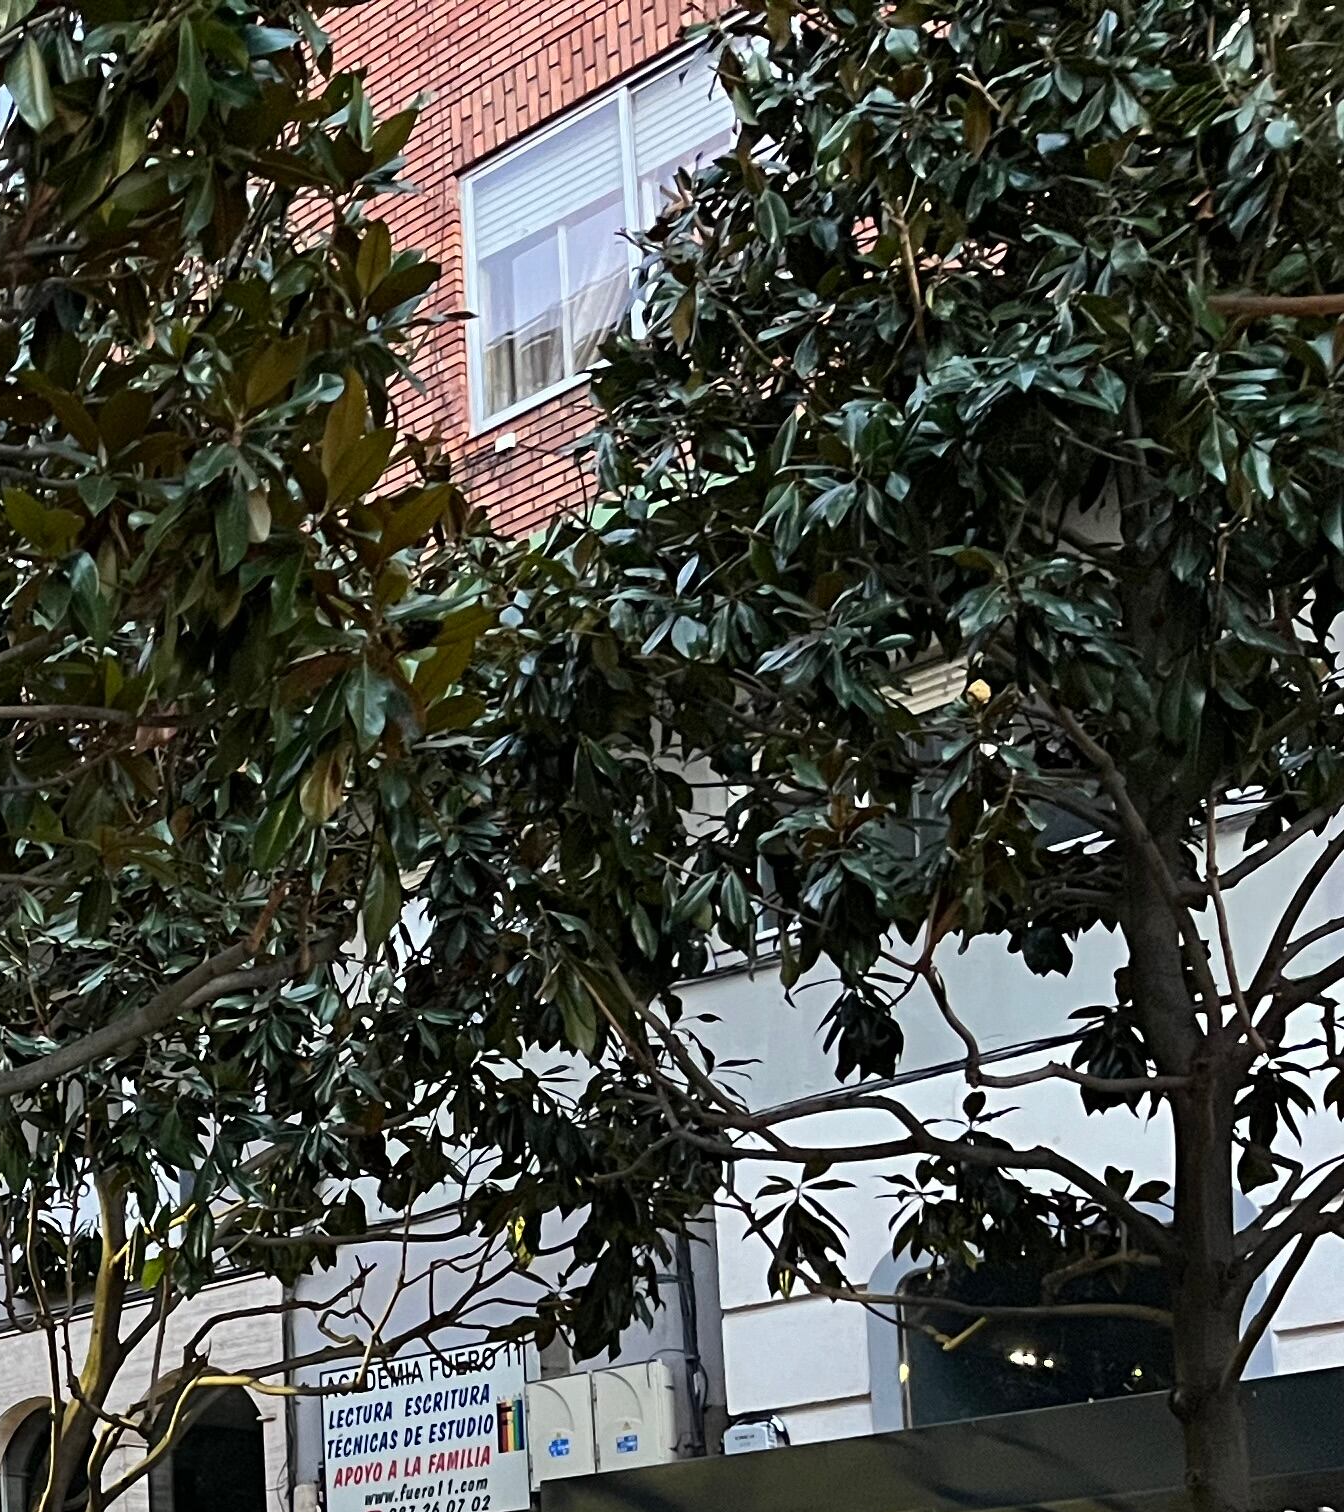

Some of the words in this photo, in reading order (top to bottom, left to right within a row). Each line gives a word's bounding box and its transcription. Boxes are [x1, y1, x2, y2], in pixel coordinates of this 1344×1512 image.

[430, 1347, 496, 1381] FUERO
[504, 1342, 522, 1367] 11
[329, 1401, 393, 1430] LECTURA
[405, 1384, 490, 1417] ESCRITURA
[327, 1430, 398, 1460] TÉCNICAS
[404, 1425, 423, 1447] DE
[429, 1414, 494, 1444] ESTUDIO
[333, 1462, 383, 1489] APOYO
[387, 1460, 398, 1481] A
[404, 1456, 422, 1477] LA
[428, 1446, 491, 1474] FAMILIA
[364, 1478, 488, 1506] www.fuero11.com
[471, 1495, 492, 1512] 02
